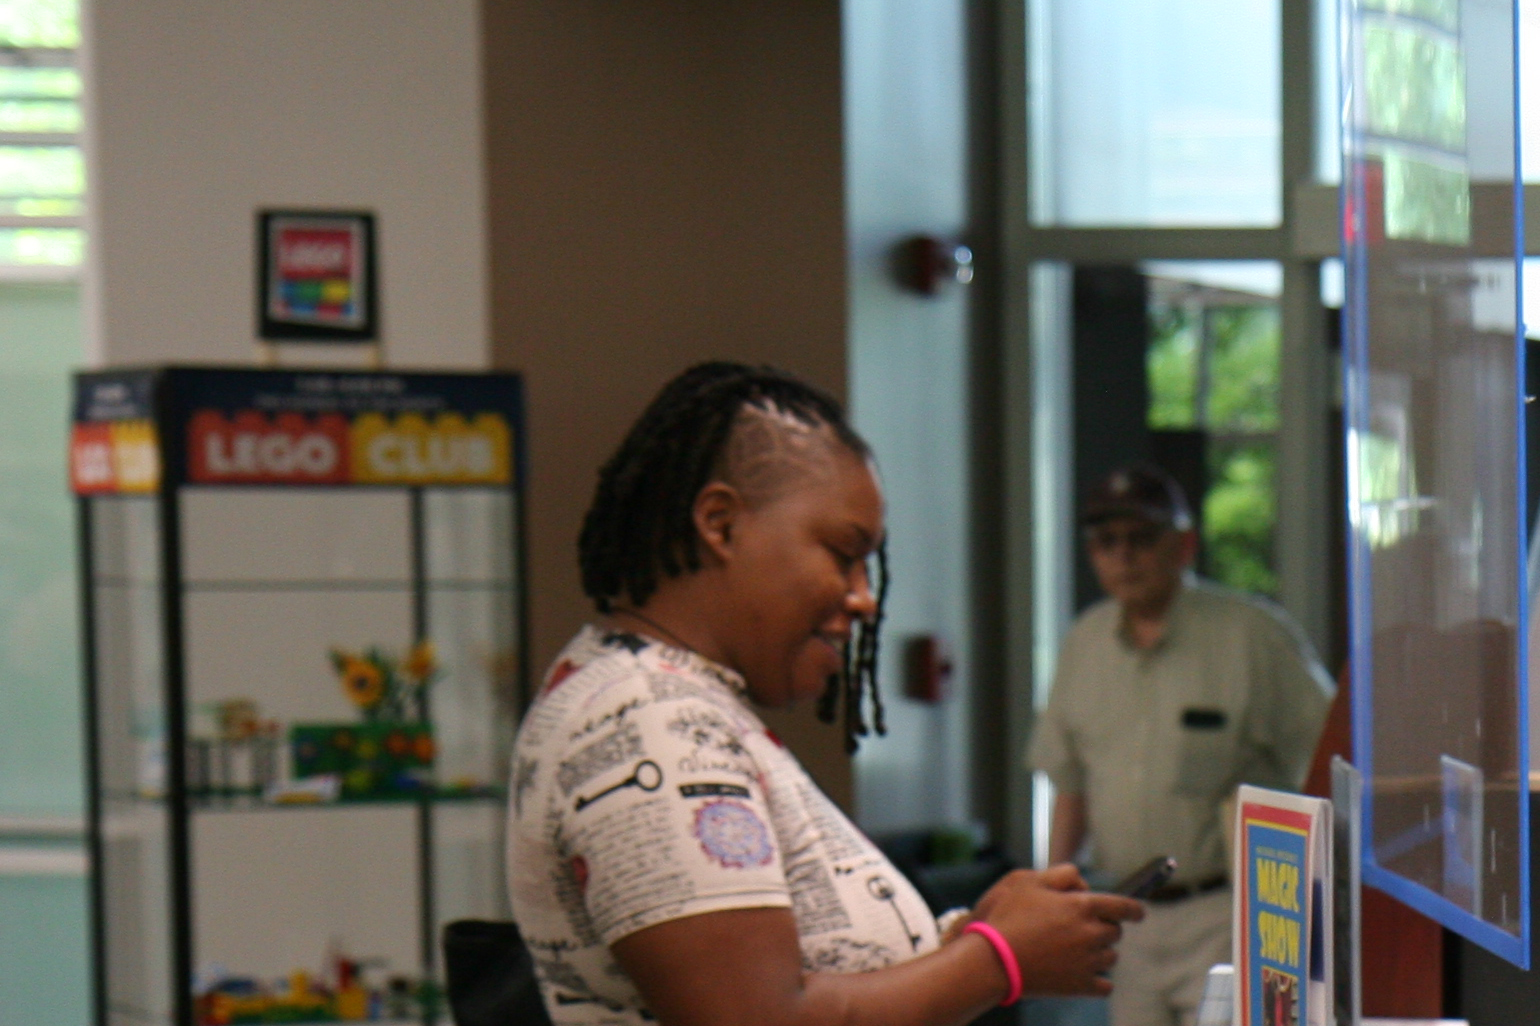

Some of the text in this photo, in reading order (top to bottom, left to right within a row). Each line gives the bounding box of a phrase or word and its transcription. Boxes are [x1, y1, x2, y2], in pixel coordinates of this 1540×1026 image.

[204, 430, 339, 476] LEGO
[366, 430, 496, 476] CLUB
[1256, 858, 1299, 912] MAGIC
[1258, 911, 1300, 968] SHOW
